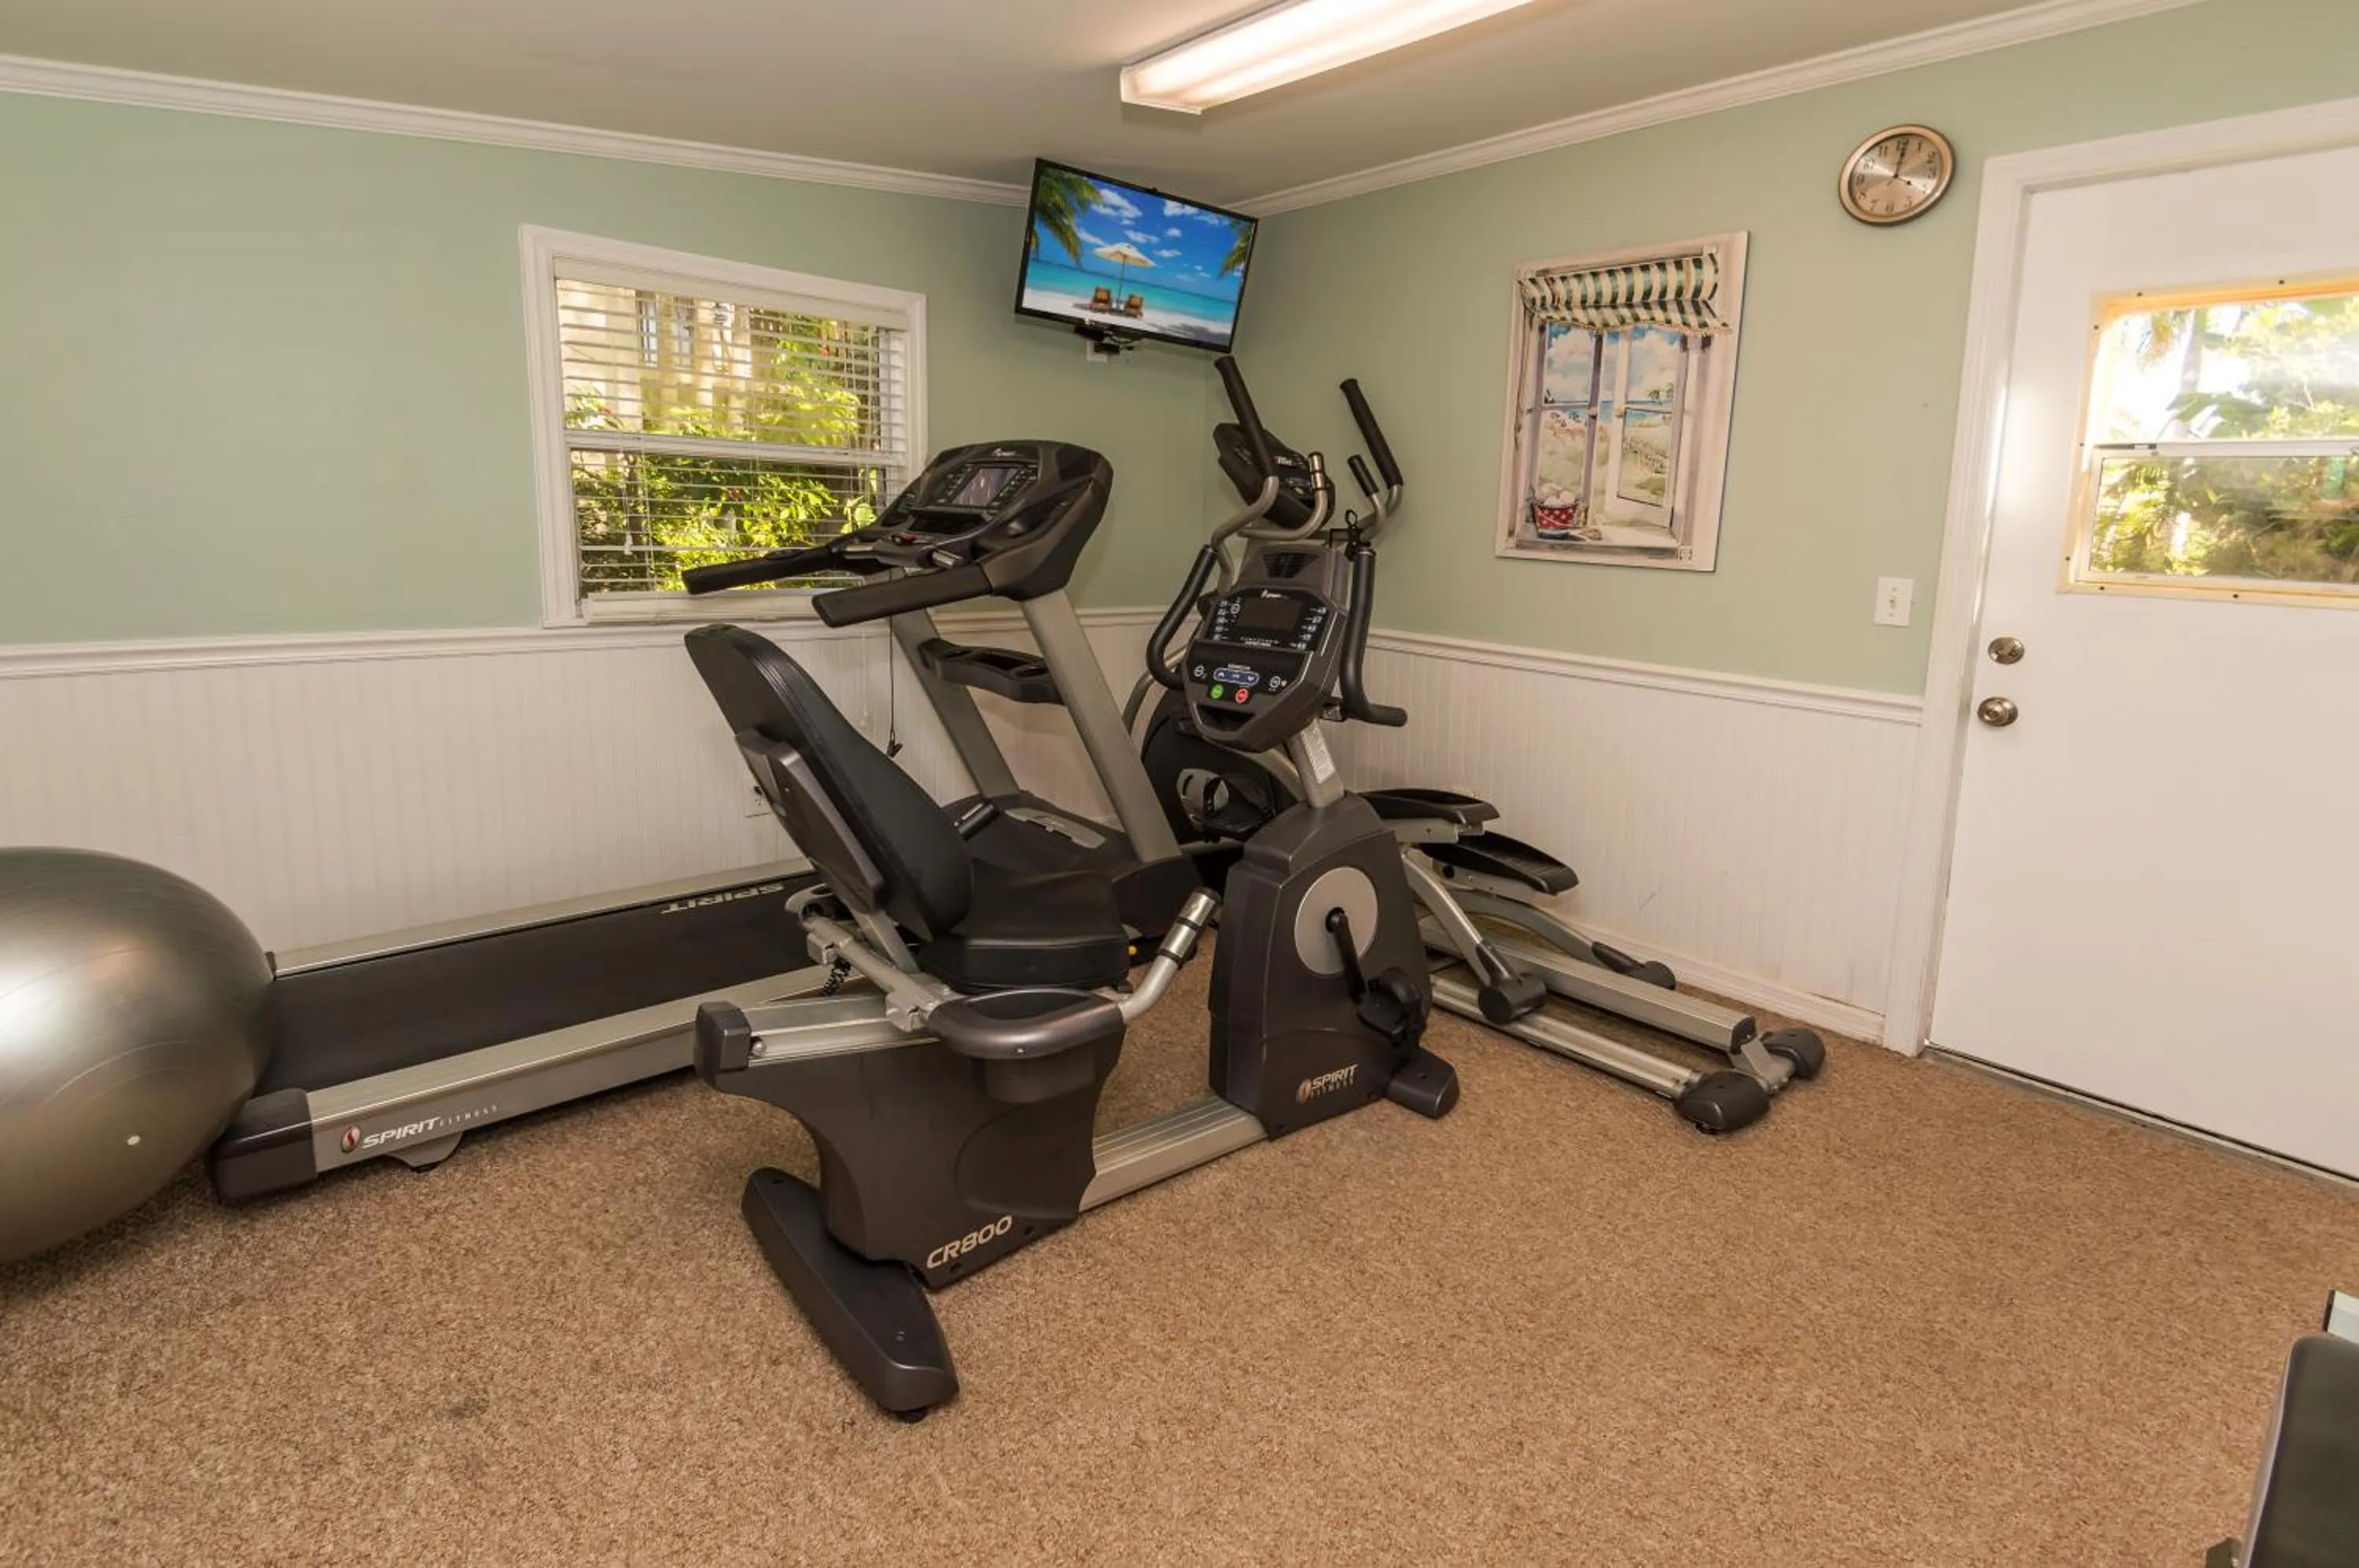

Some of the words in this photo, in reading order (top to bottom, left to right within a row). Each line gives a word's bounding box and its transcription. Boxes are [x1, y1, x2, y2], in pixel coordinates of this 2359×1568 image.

[1312, 1064, 1358, 1089] SPIRIT
[361, 1116, 442, 1150] SPIRIT
[440, 1105, 498, 1127] FITNESS
[926, 1215, 1013, 1269] CR800
